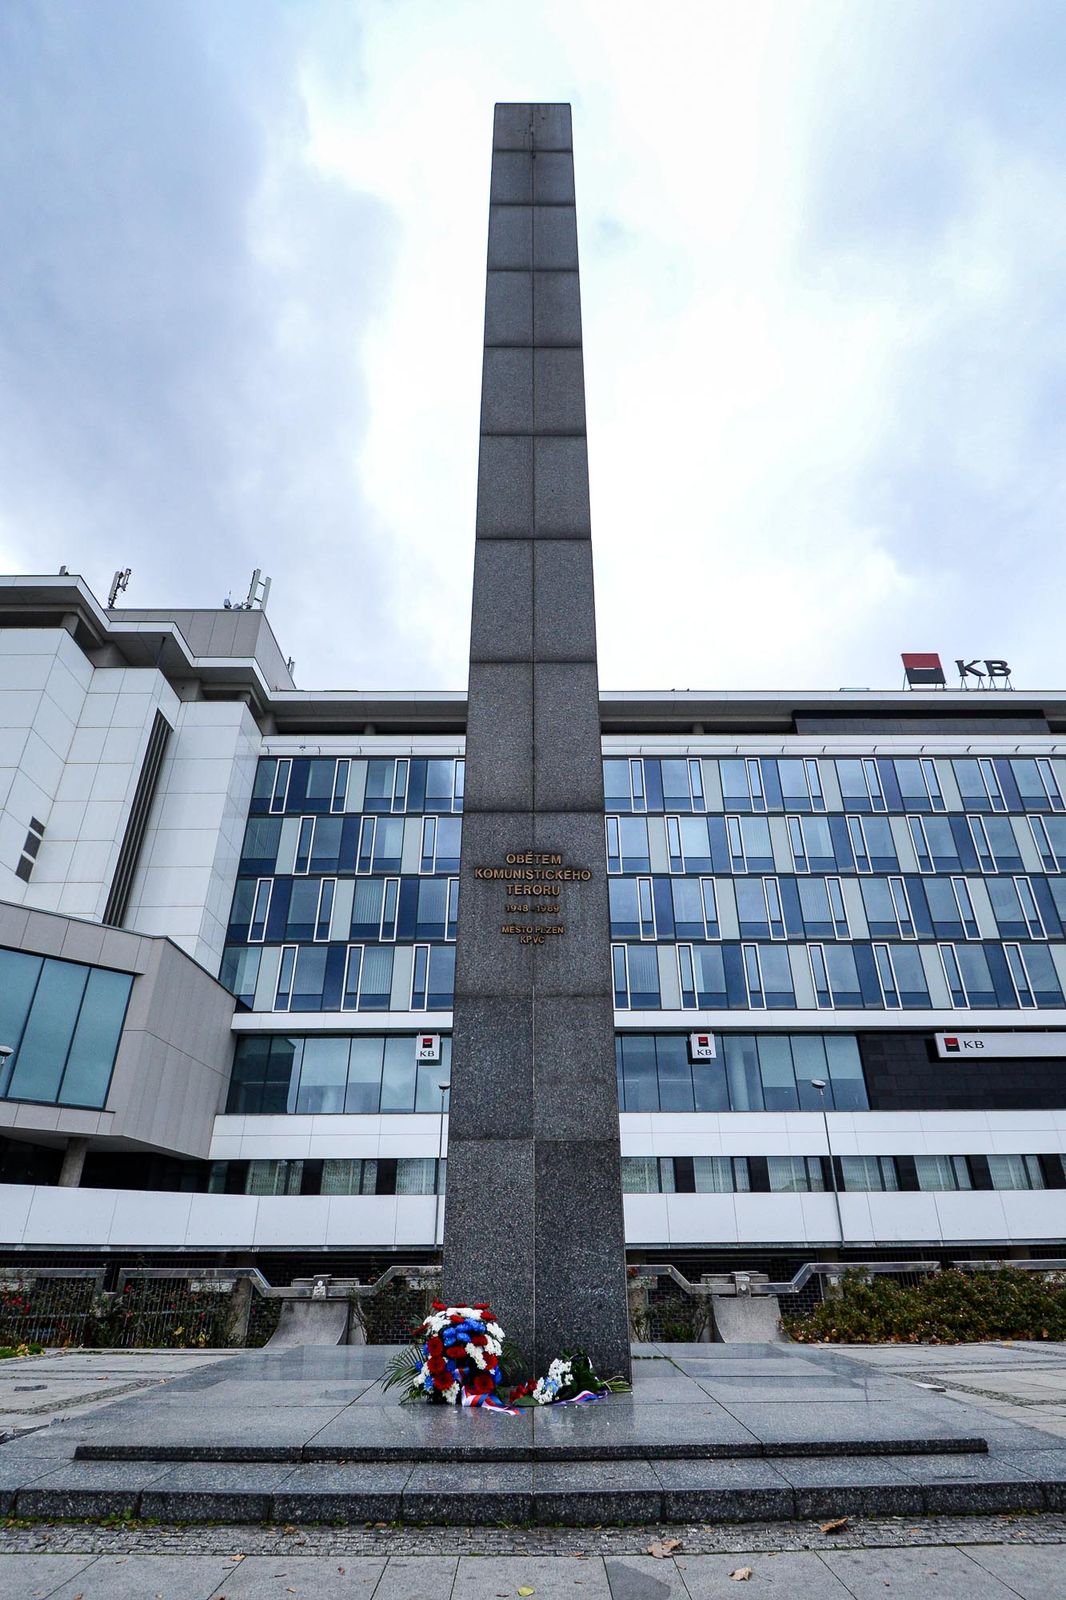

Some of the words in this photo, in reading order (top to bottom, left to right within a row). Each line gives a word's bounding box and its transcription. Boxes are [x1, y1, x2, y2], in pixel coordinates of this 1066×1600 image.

[954, 660, 1012, 677] KB
[506, 851, 562, 864] OBĚTEM
[506, 884, 561, 896] TERORU
[506, 904, 529, 913] 1948
[537, 904, 560, 913] 1989
[963, 1040, 985, 1049] KB
